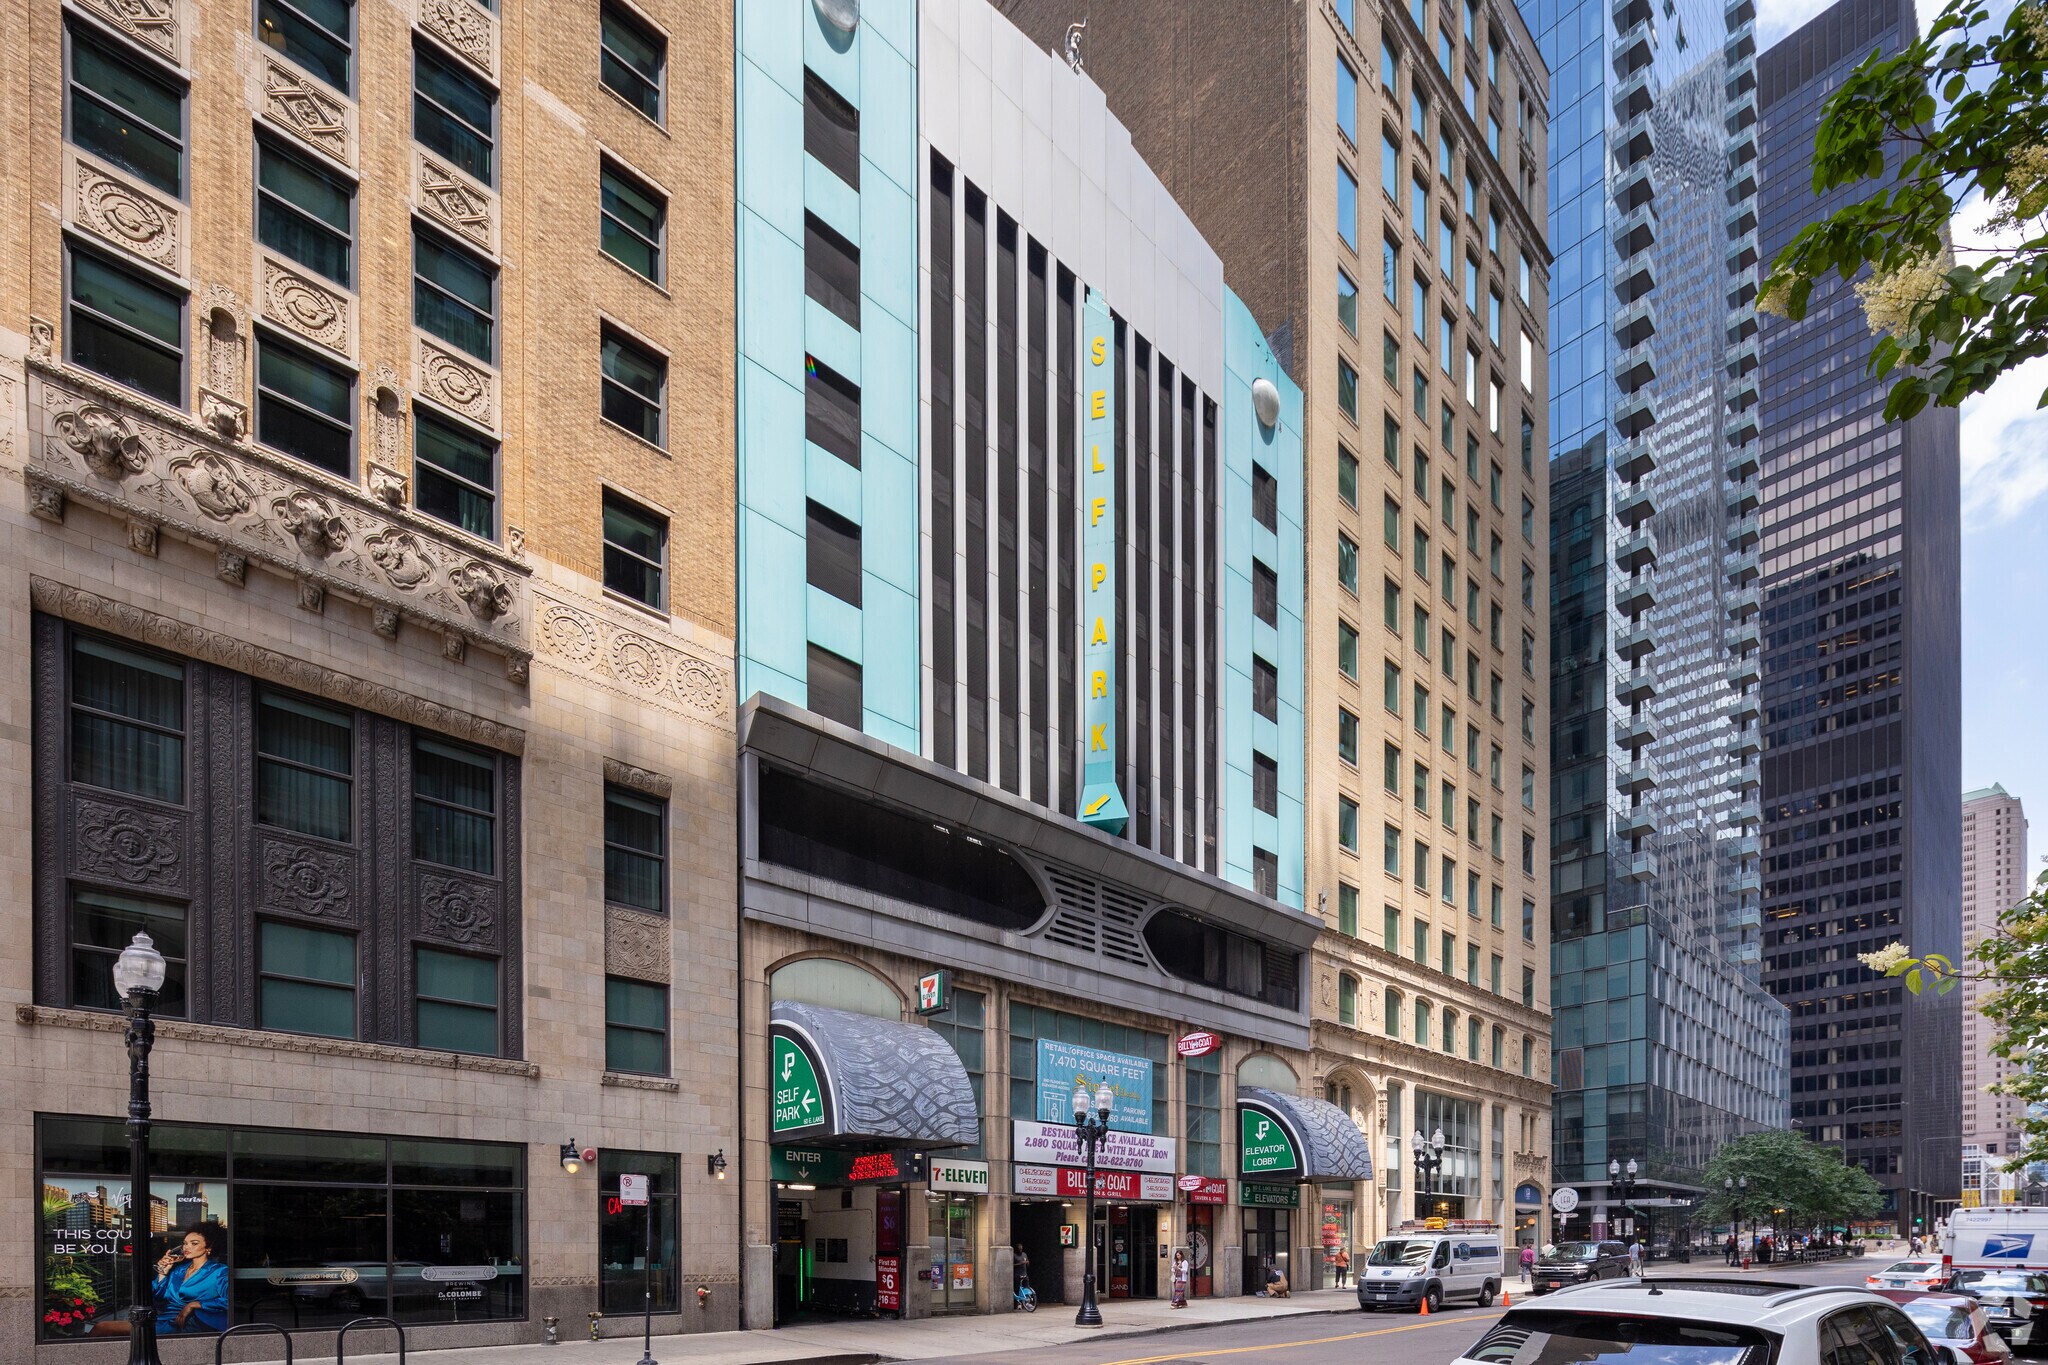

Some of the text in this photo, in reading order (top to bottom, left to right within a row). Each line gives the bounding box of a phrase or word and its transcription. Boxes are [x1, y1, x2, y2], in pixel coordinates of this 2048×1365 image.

[1091, 336, 1108, 752] SELF PARK
[1178, 1040, 1193, 1052] BILLY
[1199, 1036, 1213, 1048] GOAT
[1044, 1043, 1149, 1069] RETAIL/OFFICE SPACE AVAILABLE
[1049, 1053, 1145, 1080] 7,470 SQUARE FEET
[777, 1087, 800, 1105] SELF
[776, 1105, 800, 1123] PARK
[1123, 1106, 1146, 1116] PARKING
[1120, 1115, 1149, 1125] AVAILABLE
[1025, 1137, 1049, 1148] 2,880
[1051, 1139, 1078, 1151] SQUAR
[1107, 1145, 1126, 1156] WITH
[1128, 1147, 1150, 1158] BLACK
[1152, 1149, 1169, 1160] IRON
[1117, 1135, 1155, 1148] AVAILABLE
[786, 1151, 821, 1163] ENTER
[1245, 1144, 1285, 1156] ELEVATOR
[1056, 1151, 1079, 1163] Please
[1096, 1155, 1143, 1167] 312-622-8760
[1252, 1157, 1278, 1167] LOBBY
[1067, 1171, 1132, 1191] BILL GOAT
[1212, 1183, 1226, 1194] GOAT
[1254, 1194, 1289, 1204] ELEVATORS
[53, 1229, 91, 1240] THIS
[54, 1244, 118, 1255] BE YOU.
[882, 1274, 894, 1290] $6
